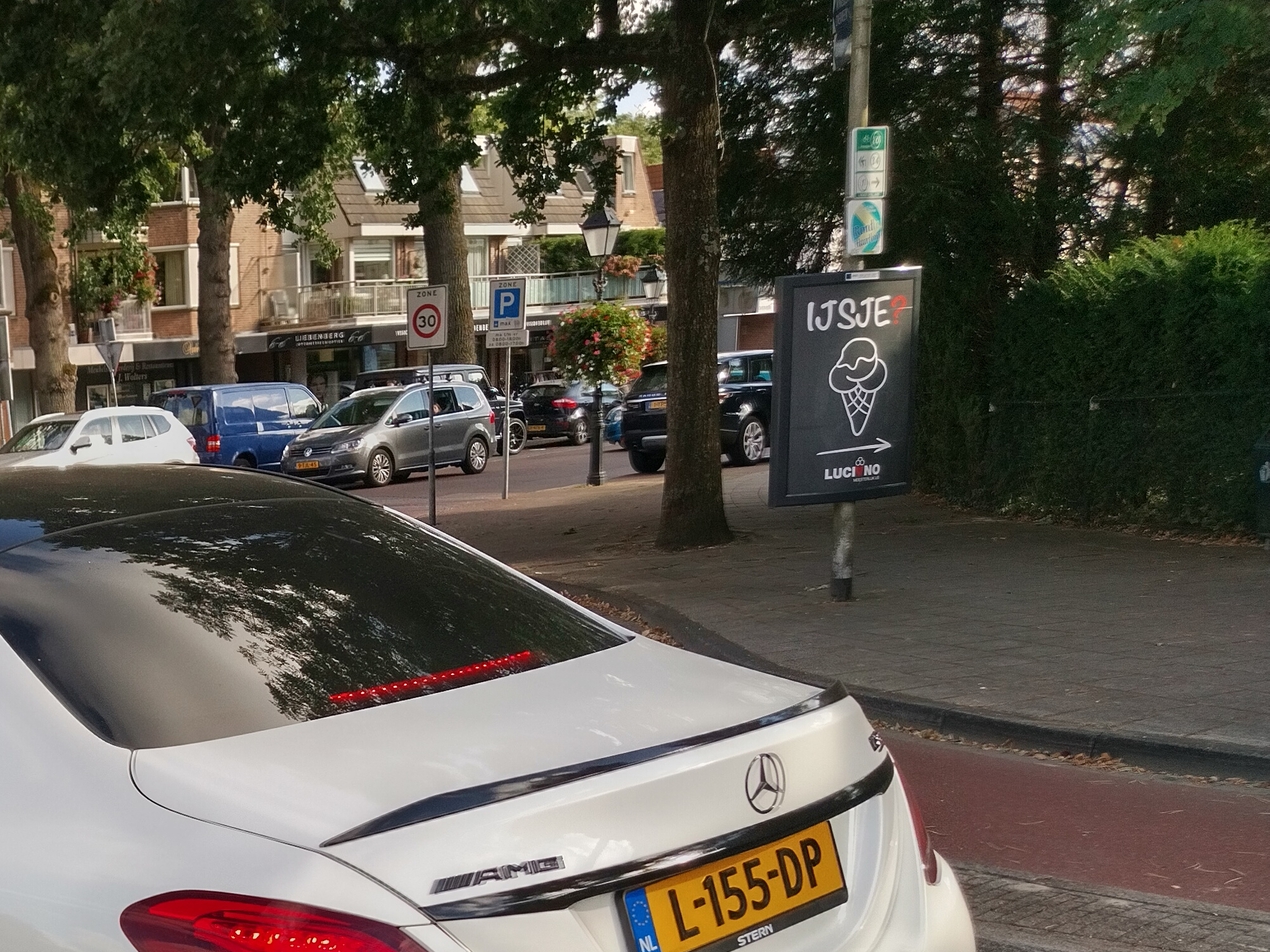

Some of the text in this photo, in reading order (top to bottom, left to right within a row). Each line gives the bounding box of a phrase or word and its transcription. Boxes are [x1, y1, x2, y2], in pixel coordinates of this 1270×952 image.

[416, 290, 438, 298] ZONE
[499, 292, 515, 316] P
[418, 314, 436, 328] 30
[807, 294, 907, 331] IJSJE?
[294, 331, 345, 343] LIEBENBERG
[824, 463, 881, 480] LUCINO
[472, 855, 566, 886] AMG
[667, 837, 822, 942] L-155-DP
[737, 923, 774, 947] STERN
